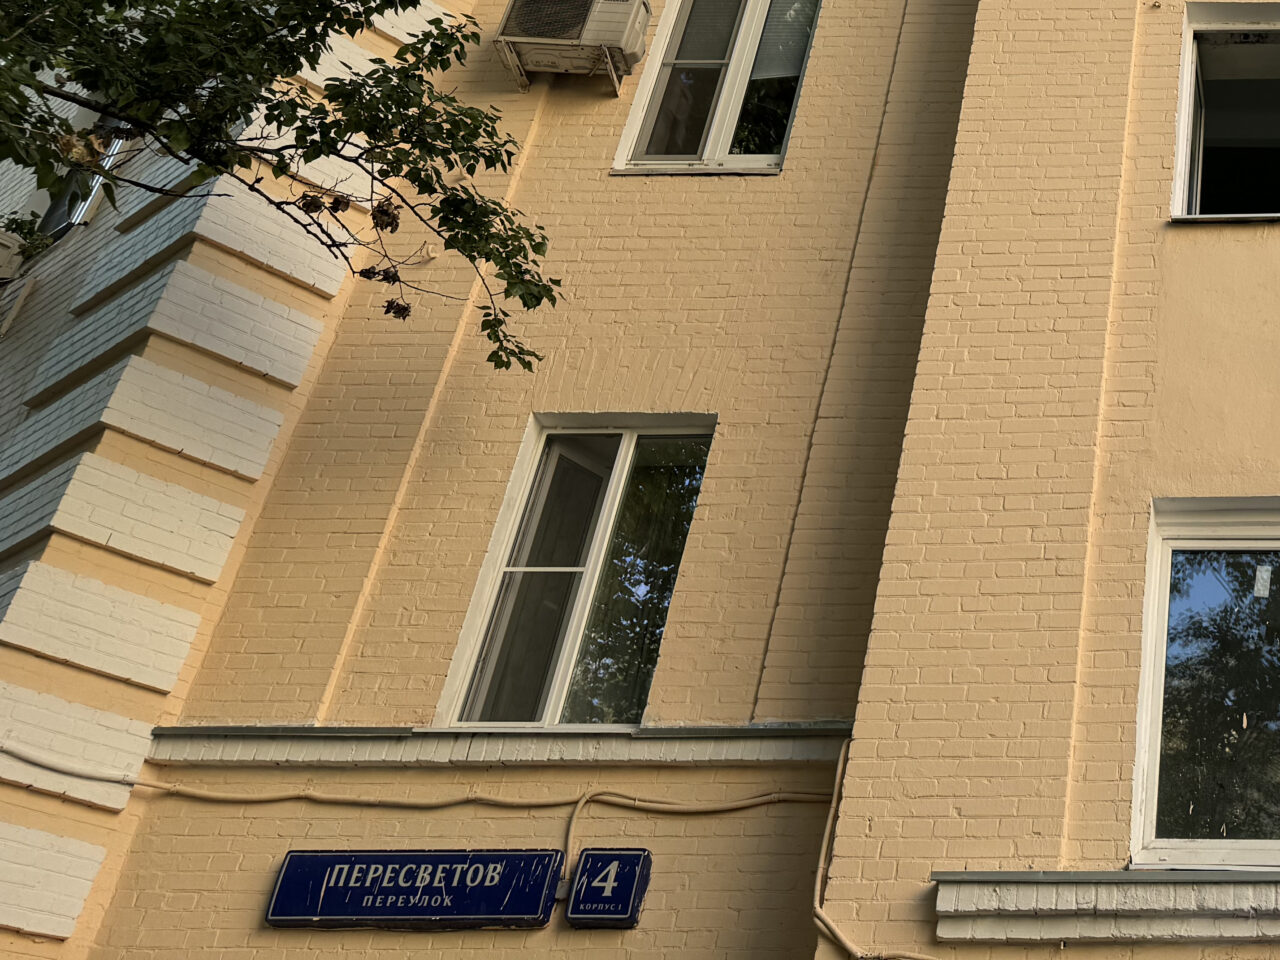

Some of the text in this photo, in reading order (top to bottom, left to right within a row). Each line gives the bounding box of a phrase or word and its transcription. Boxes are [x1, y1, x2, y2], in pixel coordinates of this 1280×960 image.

[328, 863, 501, 887] ПЕРЕСВЕТОВ
[591, 861, 619, 897] 4
[362, 895, 454, 907] ПЕРЕУЛОК
